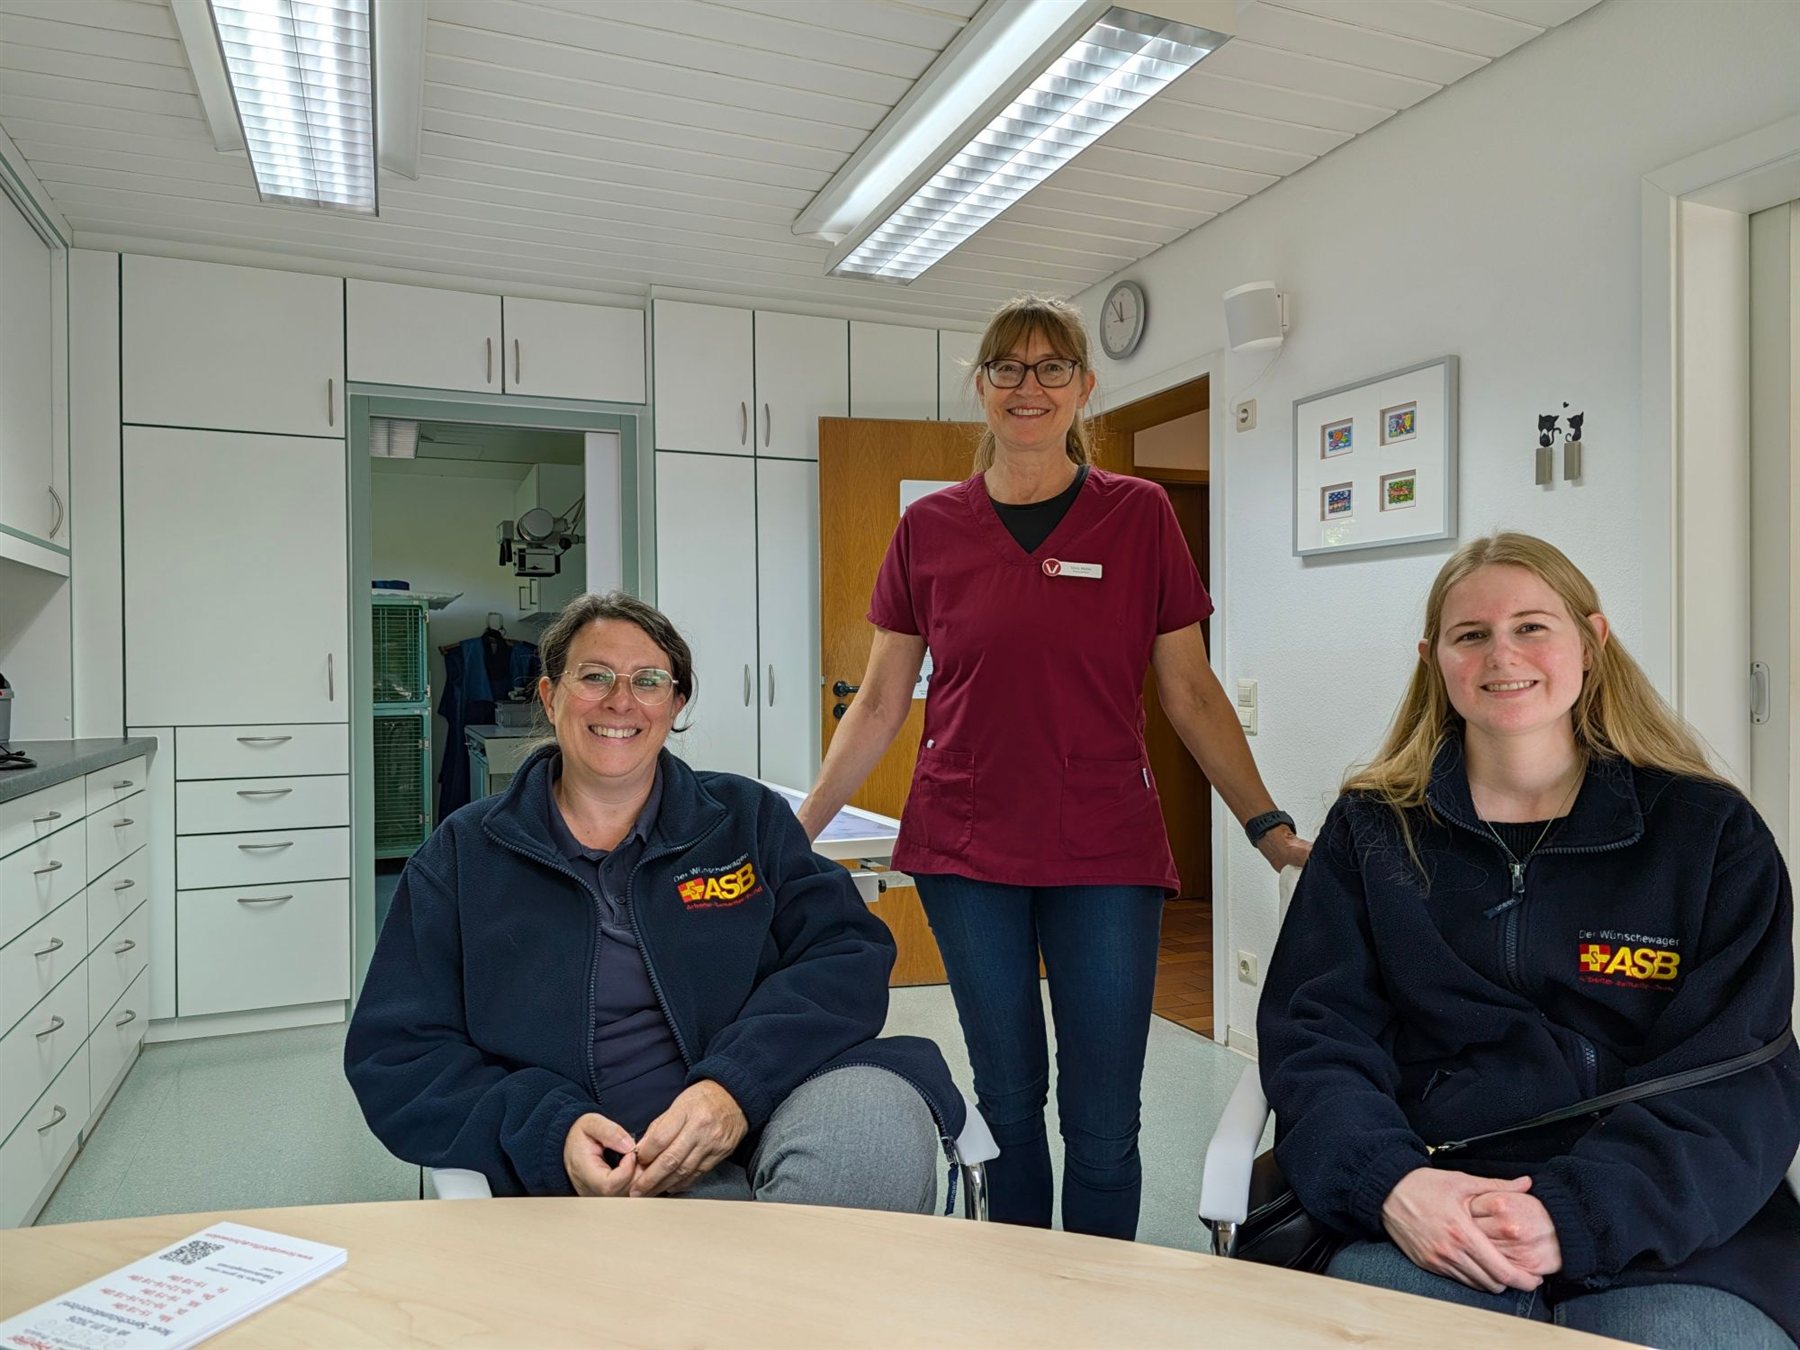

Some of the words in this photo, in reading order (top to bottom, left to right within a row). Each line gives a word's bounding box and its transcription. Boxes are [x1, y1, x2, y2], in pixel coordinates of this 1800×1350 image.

[703, 862, 756, 900] ASB
[1579, 929, 1596, 939] Der
[1603, 946, 1681, 980] ASB
